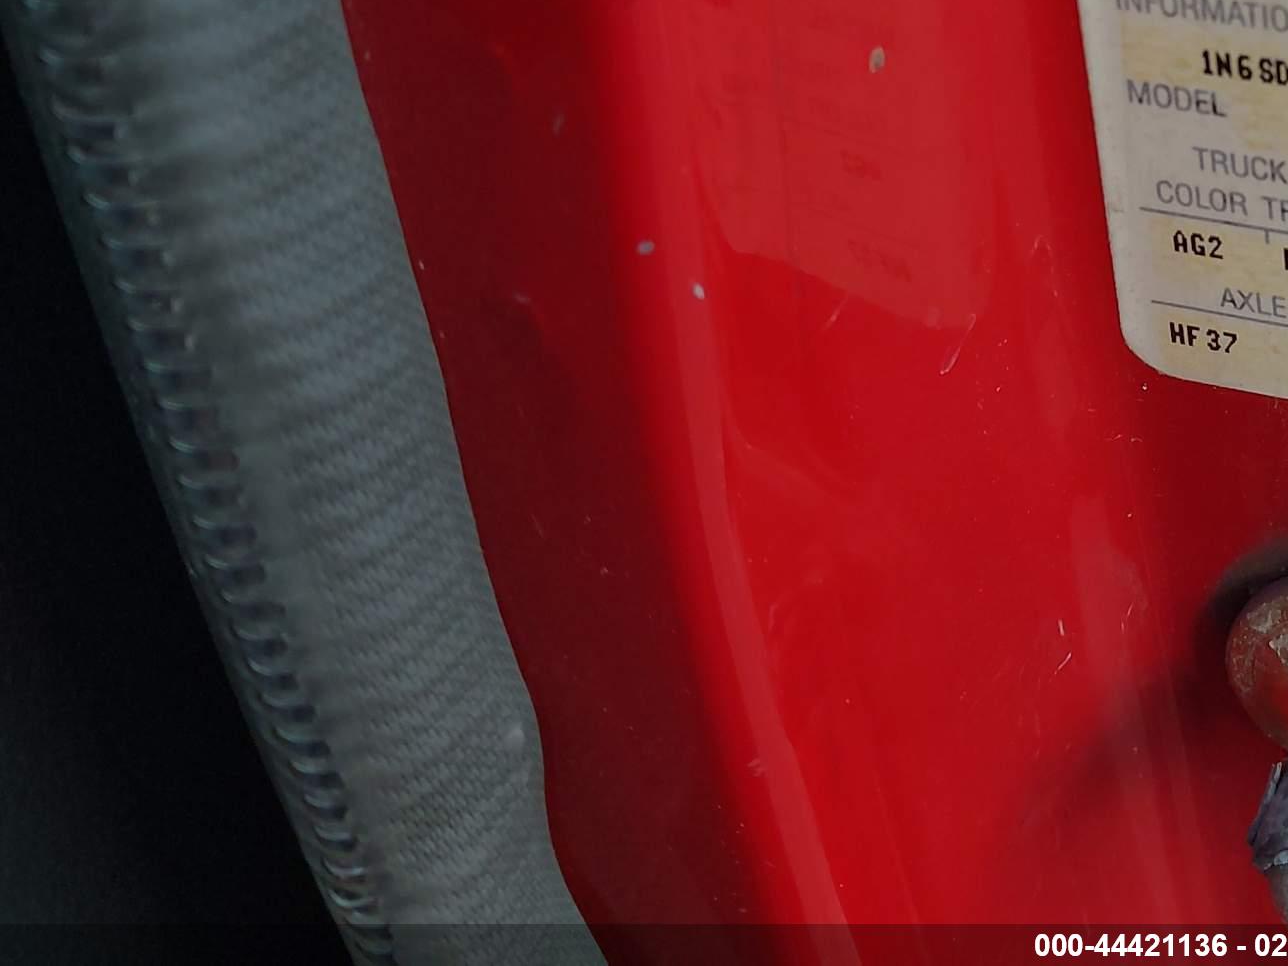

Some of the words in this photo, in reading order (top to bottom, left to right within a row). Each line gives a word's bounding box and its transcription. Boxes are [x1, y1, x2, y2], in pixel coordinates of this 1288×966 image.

[1126, 81, 1227, 118] MODEL
[1193, 147, 1288, 185] TRUCK
[1156, 181, 1248, 218] COLOR
[1173, 230, 1224, 261] AG2
[1220, 287, 1288, 319] AXLE
[1169, 322, 1239, 354] HF37
